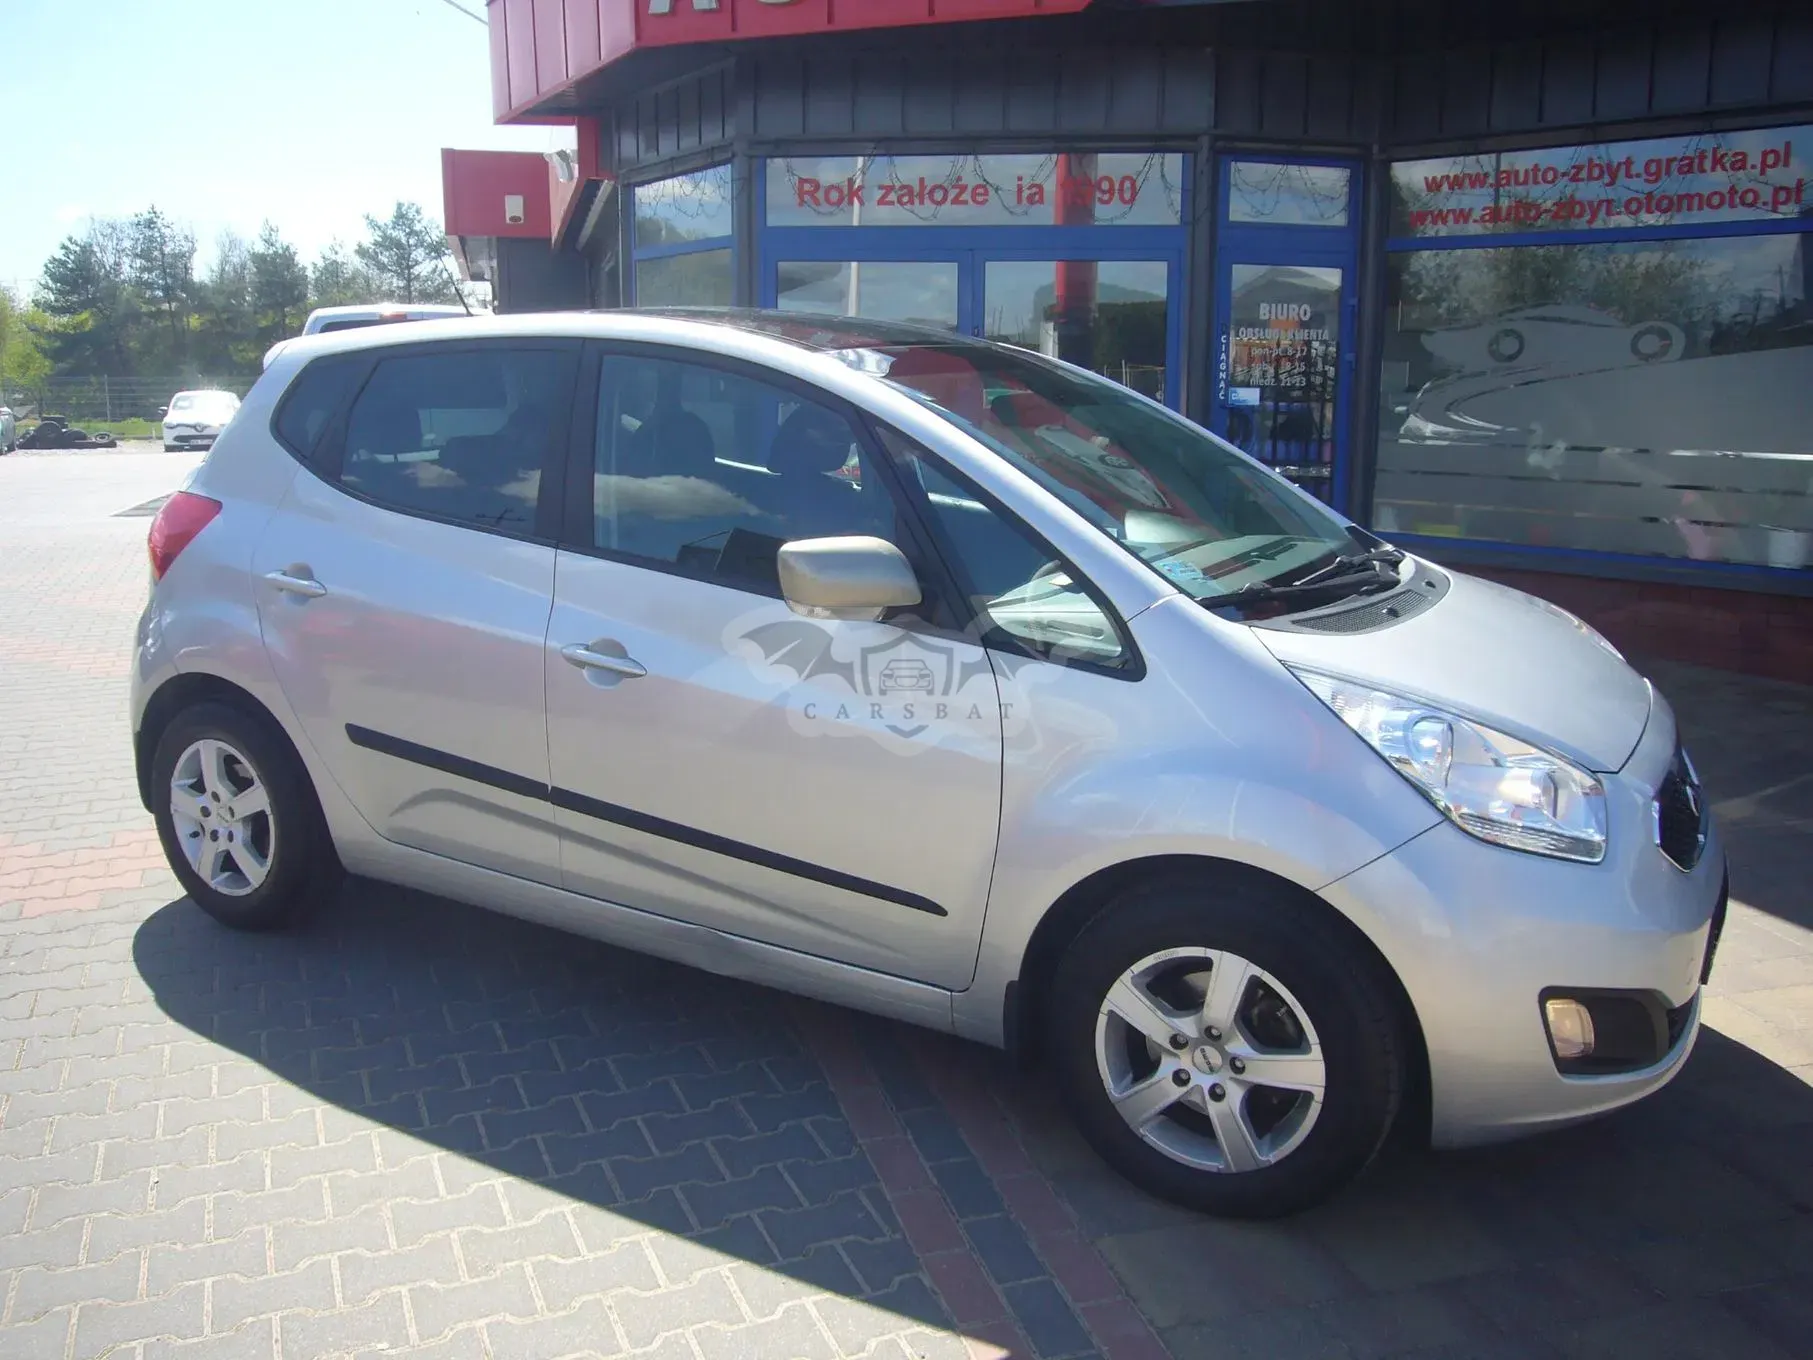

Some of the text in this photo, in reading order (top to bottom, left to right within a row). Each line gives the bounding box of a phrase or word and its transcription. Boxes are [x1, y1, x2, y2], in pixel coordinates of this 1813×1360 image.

[1424, 141, 1792, 193] www.auto-zbyt.gratka.pl
[796, 177, 864, 207] Rok
[1409, 178, 1805, 229] www.auto-zbyt.otomoto.pl
[1259, 303, 1311, 321] BIURO
